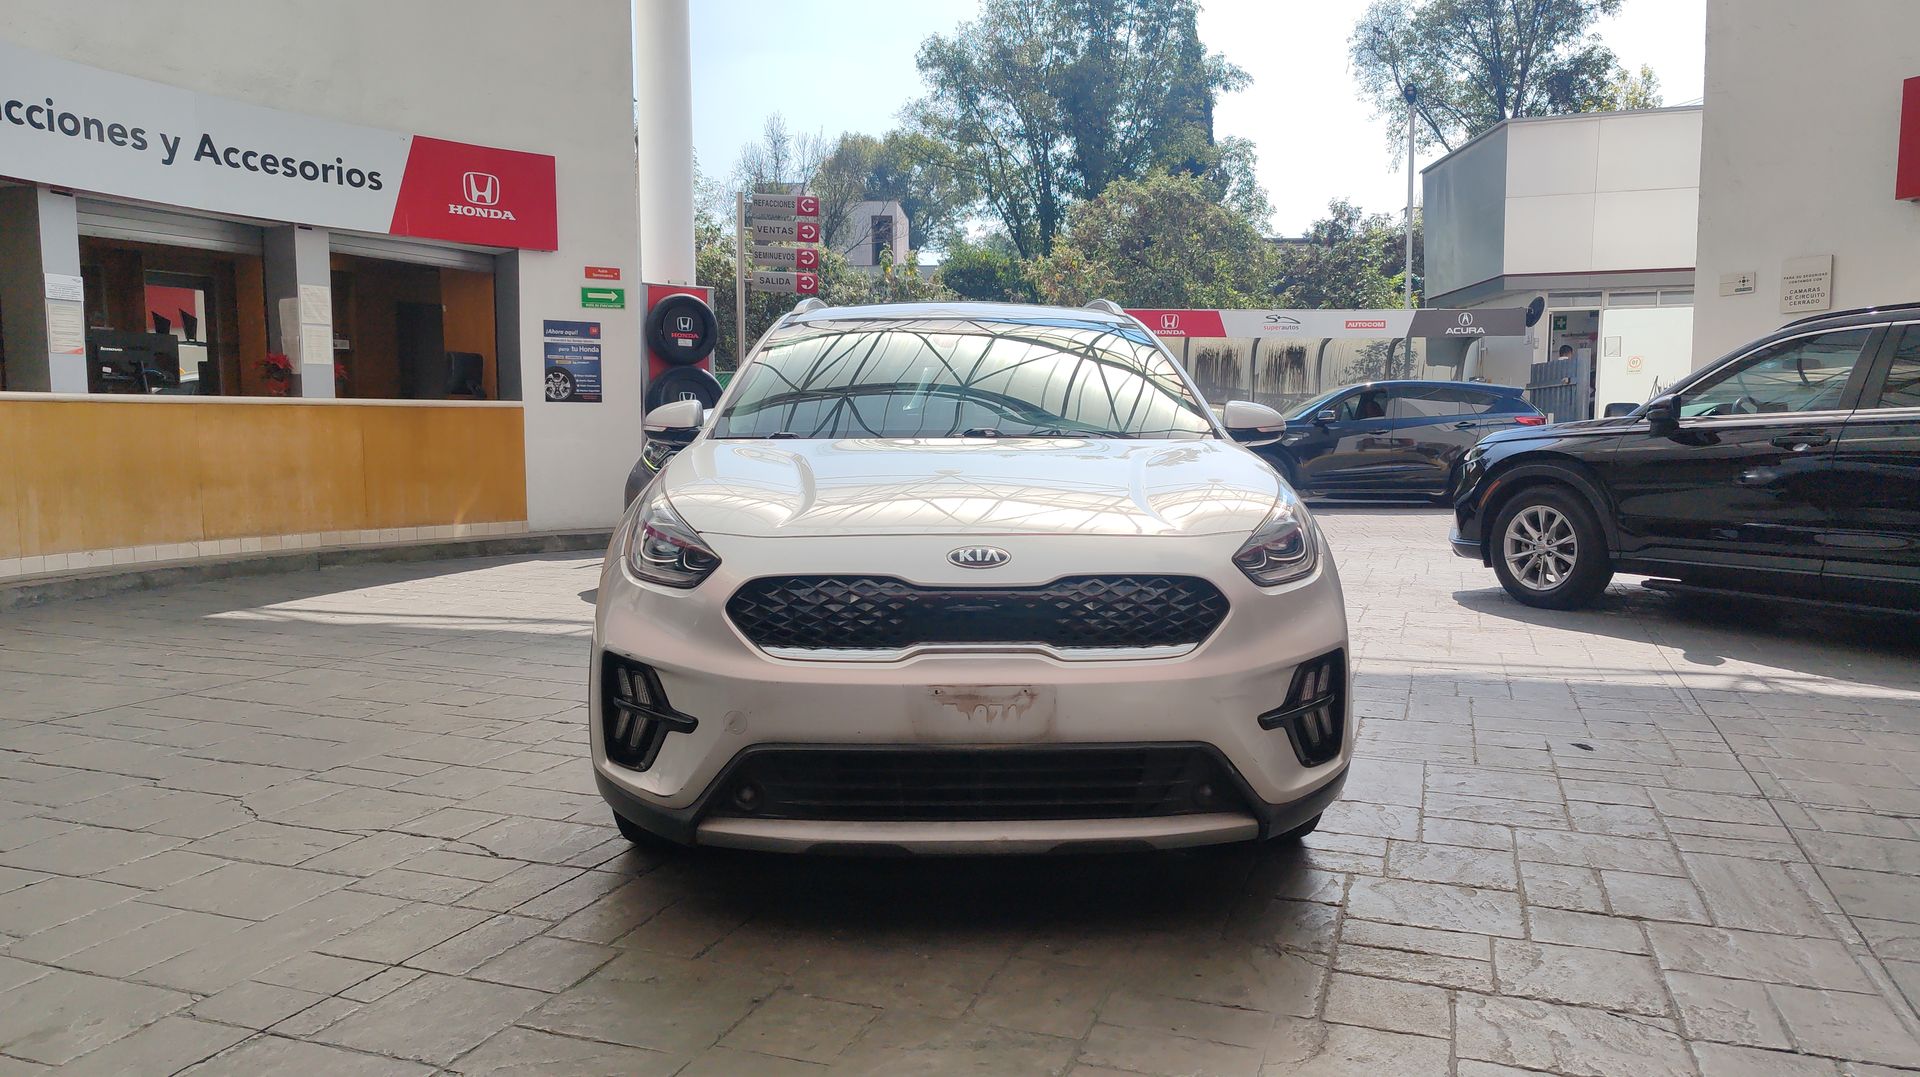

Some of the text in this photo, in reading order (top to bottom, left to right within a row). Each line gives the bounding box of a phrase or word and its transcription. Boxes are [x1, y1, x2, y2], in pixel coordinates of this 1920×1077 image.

[0, 97, 383, 191] cciones y Accesorios
[753, 199, 796, 209] REFACCIONES
[448, 203, 516, 221] HONDA
[756, 225, 794, 235] VENTAS
[754, 250, 796, 261] SEMINUEVOS
[759, 276, 791, 286] SALIDA
[1789, 286, 1821, 295] CAMARAS
[1794, 292, 1826, 300] CIRCUITO
[1789, 298, 1820, 306] CERRADO
[959, 549, 1001, 562] KIA
